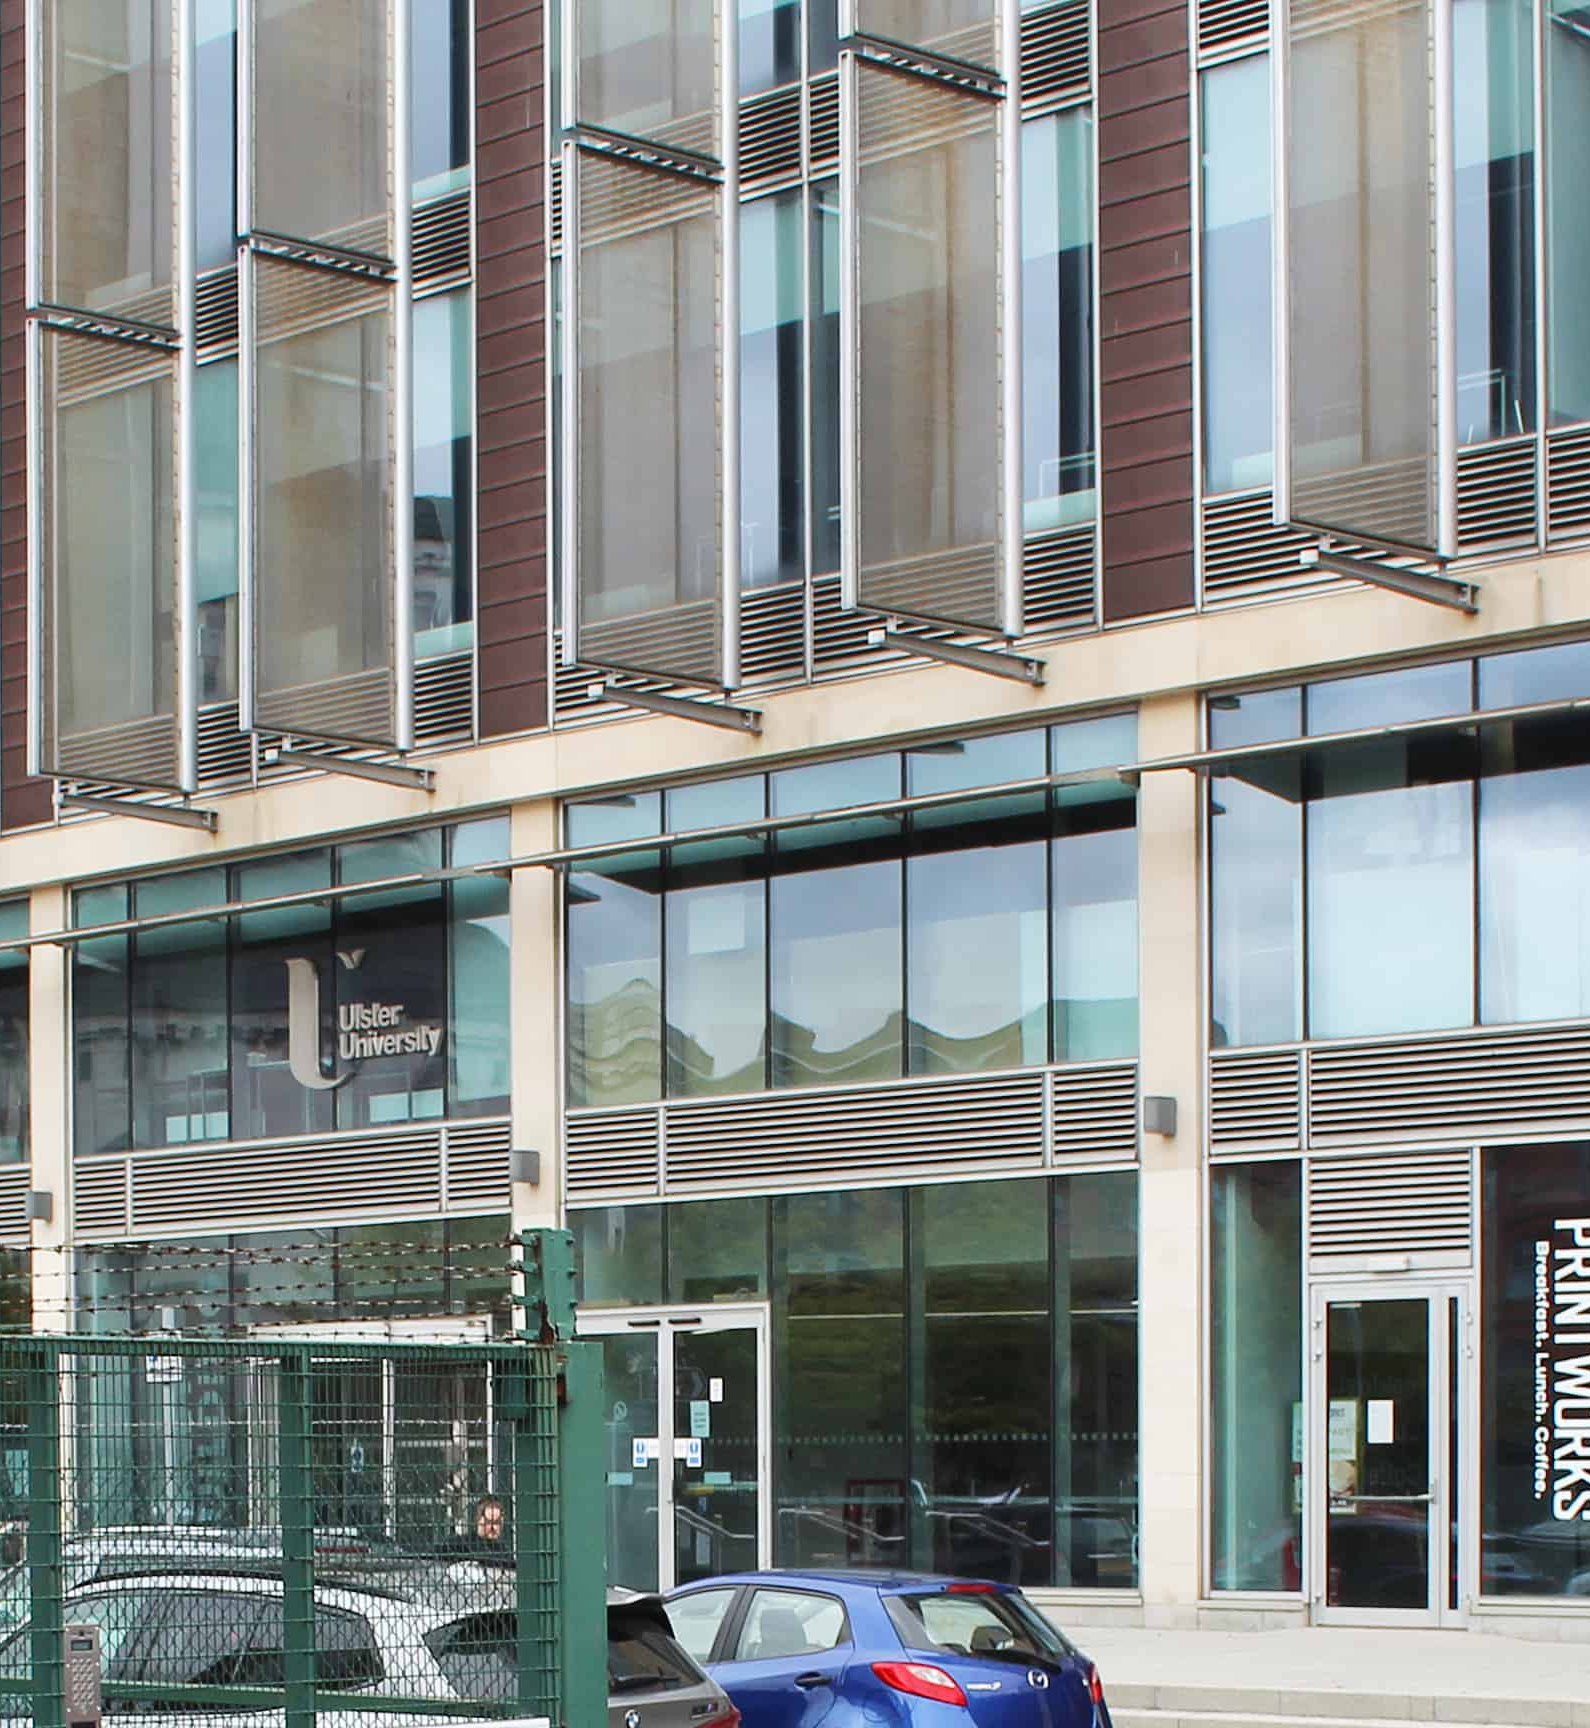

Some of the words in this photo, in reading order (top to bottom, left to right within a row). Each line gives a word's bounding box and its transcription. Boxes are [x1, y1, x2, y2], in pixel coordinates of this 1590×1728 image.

[338, 1002, 405, 1032] Ulster
[338, 1025, 443, 1061] University
[1534, 1240, 1550, 1348] Breakfast.
[1534, 1352, 1550, 1423] Lunch.
[1533, 1426, 1550, 1500] Coffee.
